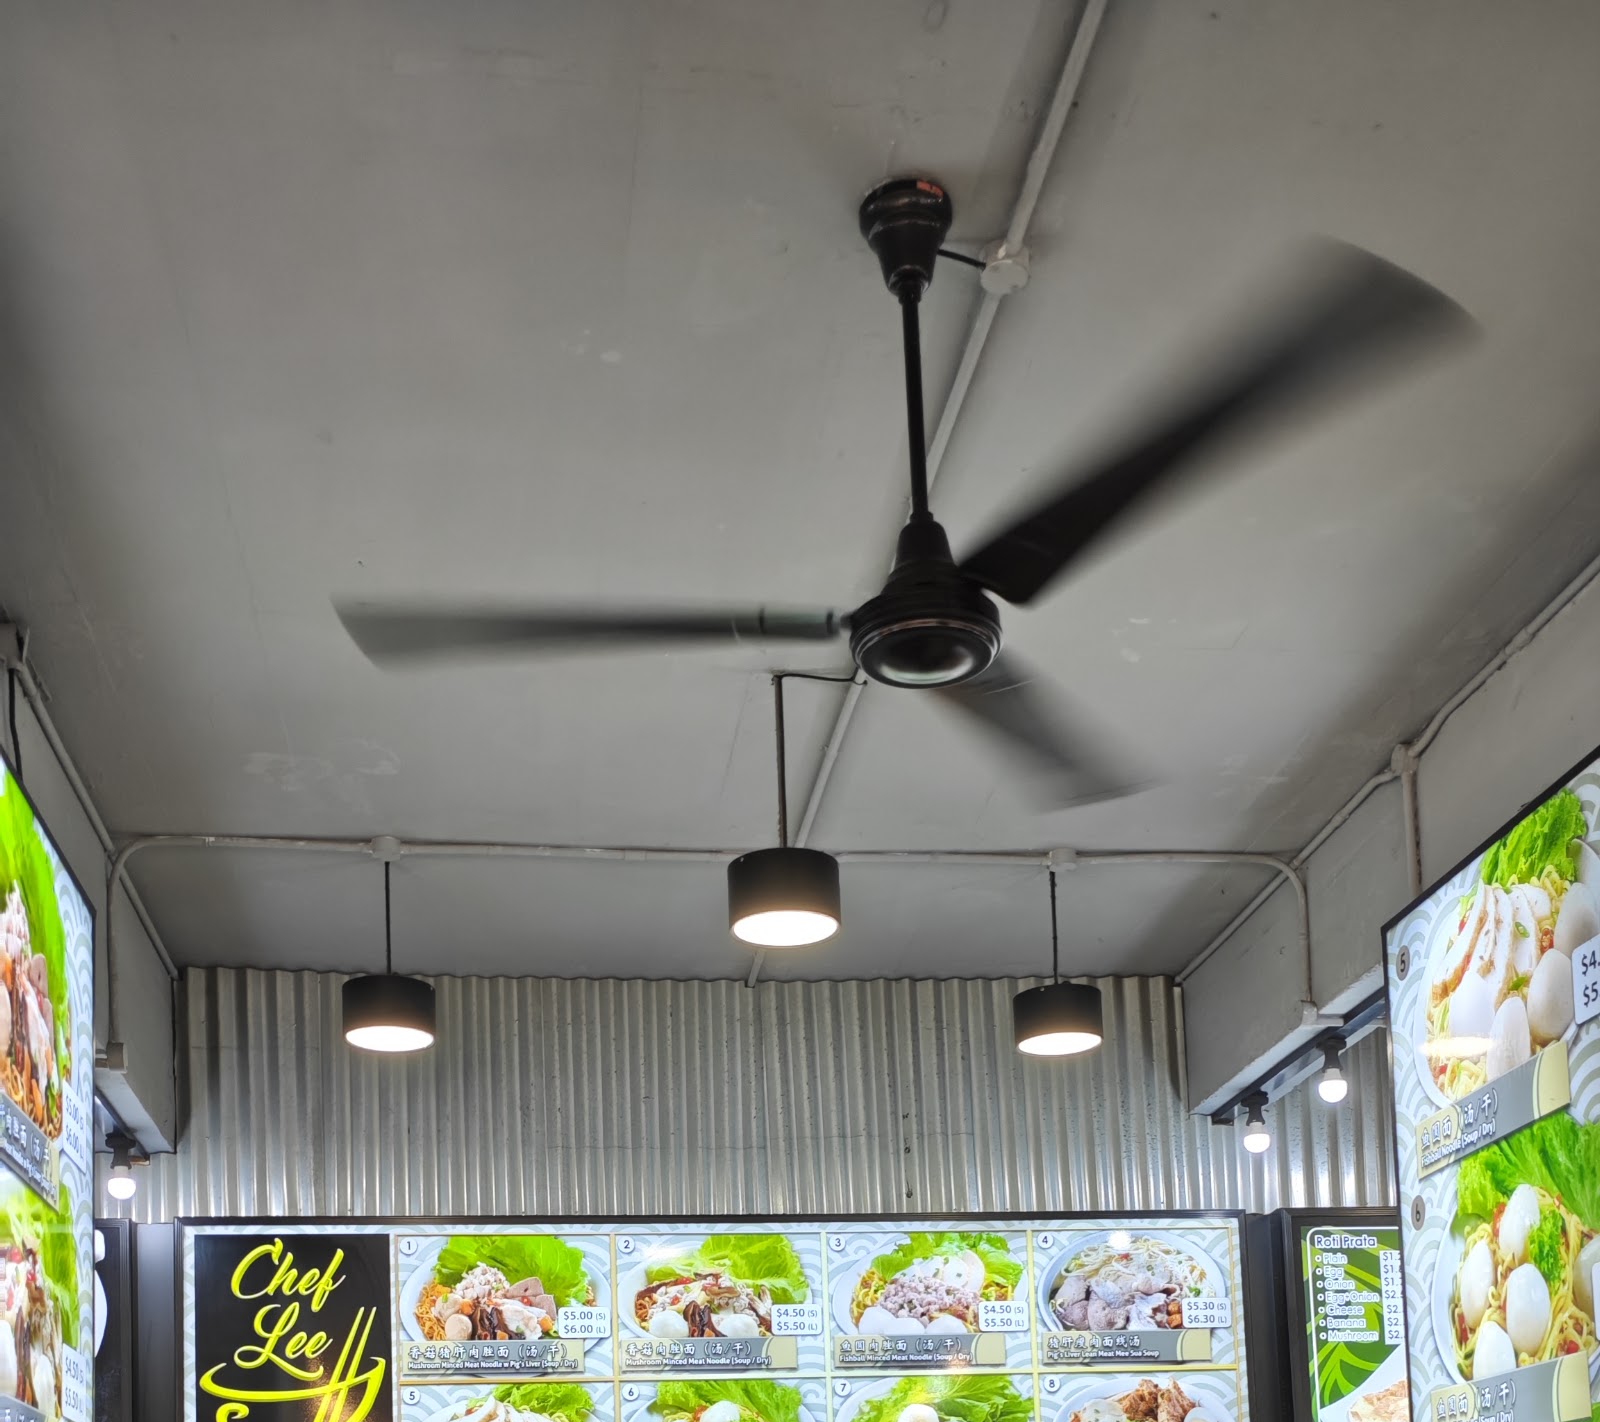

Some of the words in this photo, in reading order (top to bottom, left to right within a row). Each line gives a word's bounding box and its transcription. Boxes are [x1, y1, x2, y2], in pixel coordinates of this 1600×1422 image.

[1400, 952, 1406, 973] 5
[1416, 1204, 1420, 1222] 6
[1316, 1236, 1339, 1247] Roti
[1343, 1236, 1376, 1247] Prata
[1324, 1254, 1346, 1263] Plain
[231, 1238, 346, 1312] Chef
[1325, 1267, 1343, 1278] Egg
[1326, 1293, 1379, 1303] Egg+Onion
[983, 1305, 1011, 1314] $4.50
[1014, 1306, 1024, 1314] (S)
[1187, 1302, 1214, 1311] $5.30
[1217, 1303, 1227, 1311] (S)
[1327, 1306, 1363, 1314] Cheese
[564, 1311, 593, 1320] $5.00
[595, 1313, 606, 1321] (S)
[776, 1308, 805, 1318] $4.50
[807, 1310, 817, 1318] (S)
[984, 1318, 1012, 1327] $5.50
[1187, 1315, 1215, 1324] $6.30
[1328, 1319, 1365, 1327] Banana
[564, 1325, 593, 1334] $6.00
[595, 1326, 606, 1334] (L)
[777, 1321, 805, 1331] $5.50
[808, 1323, 818, 1331] (L)
[1329, 1331, 1378, 1340] Mushroom
[233, 1302, 331, 1380] Lee
[934, 1353, 952, 1362] (Soup
[958, 1353, 973, 1362] Dry)
[1047, 1351, 1063, 1359] Pig's
[1143, 1350, 1159, 1358] Soup
[408, 1361, 440, 1369] Mushroom
[442, 1361, 463, 1369] Minced
[510, 1360, 525, 1369] Pig's
[526, 1360, 541, 1368] Liver
[541, 1360, 559, 1369] (Soup
[564, 1360, 578, 1369] Dry)
[689, 1357, 705, 1365] Meat
[732, 1357, 751, 1366] (Soup
[756, 1356, 772, 1365] Dry)
[408, 1392, 415, 1401] 5
